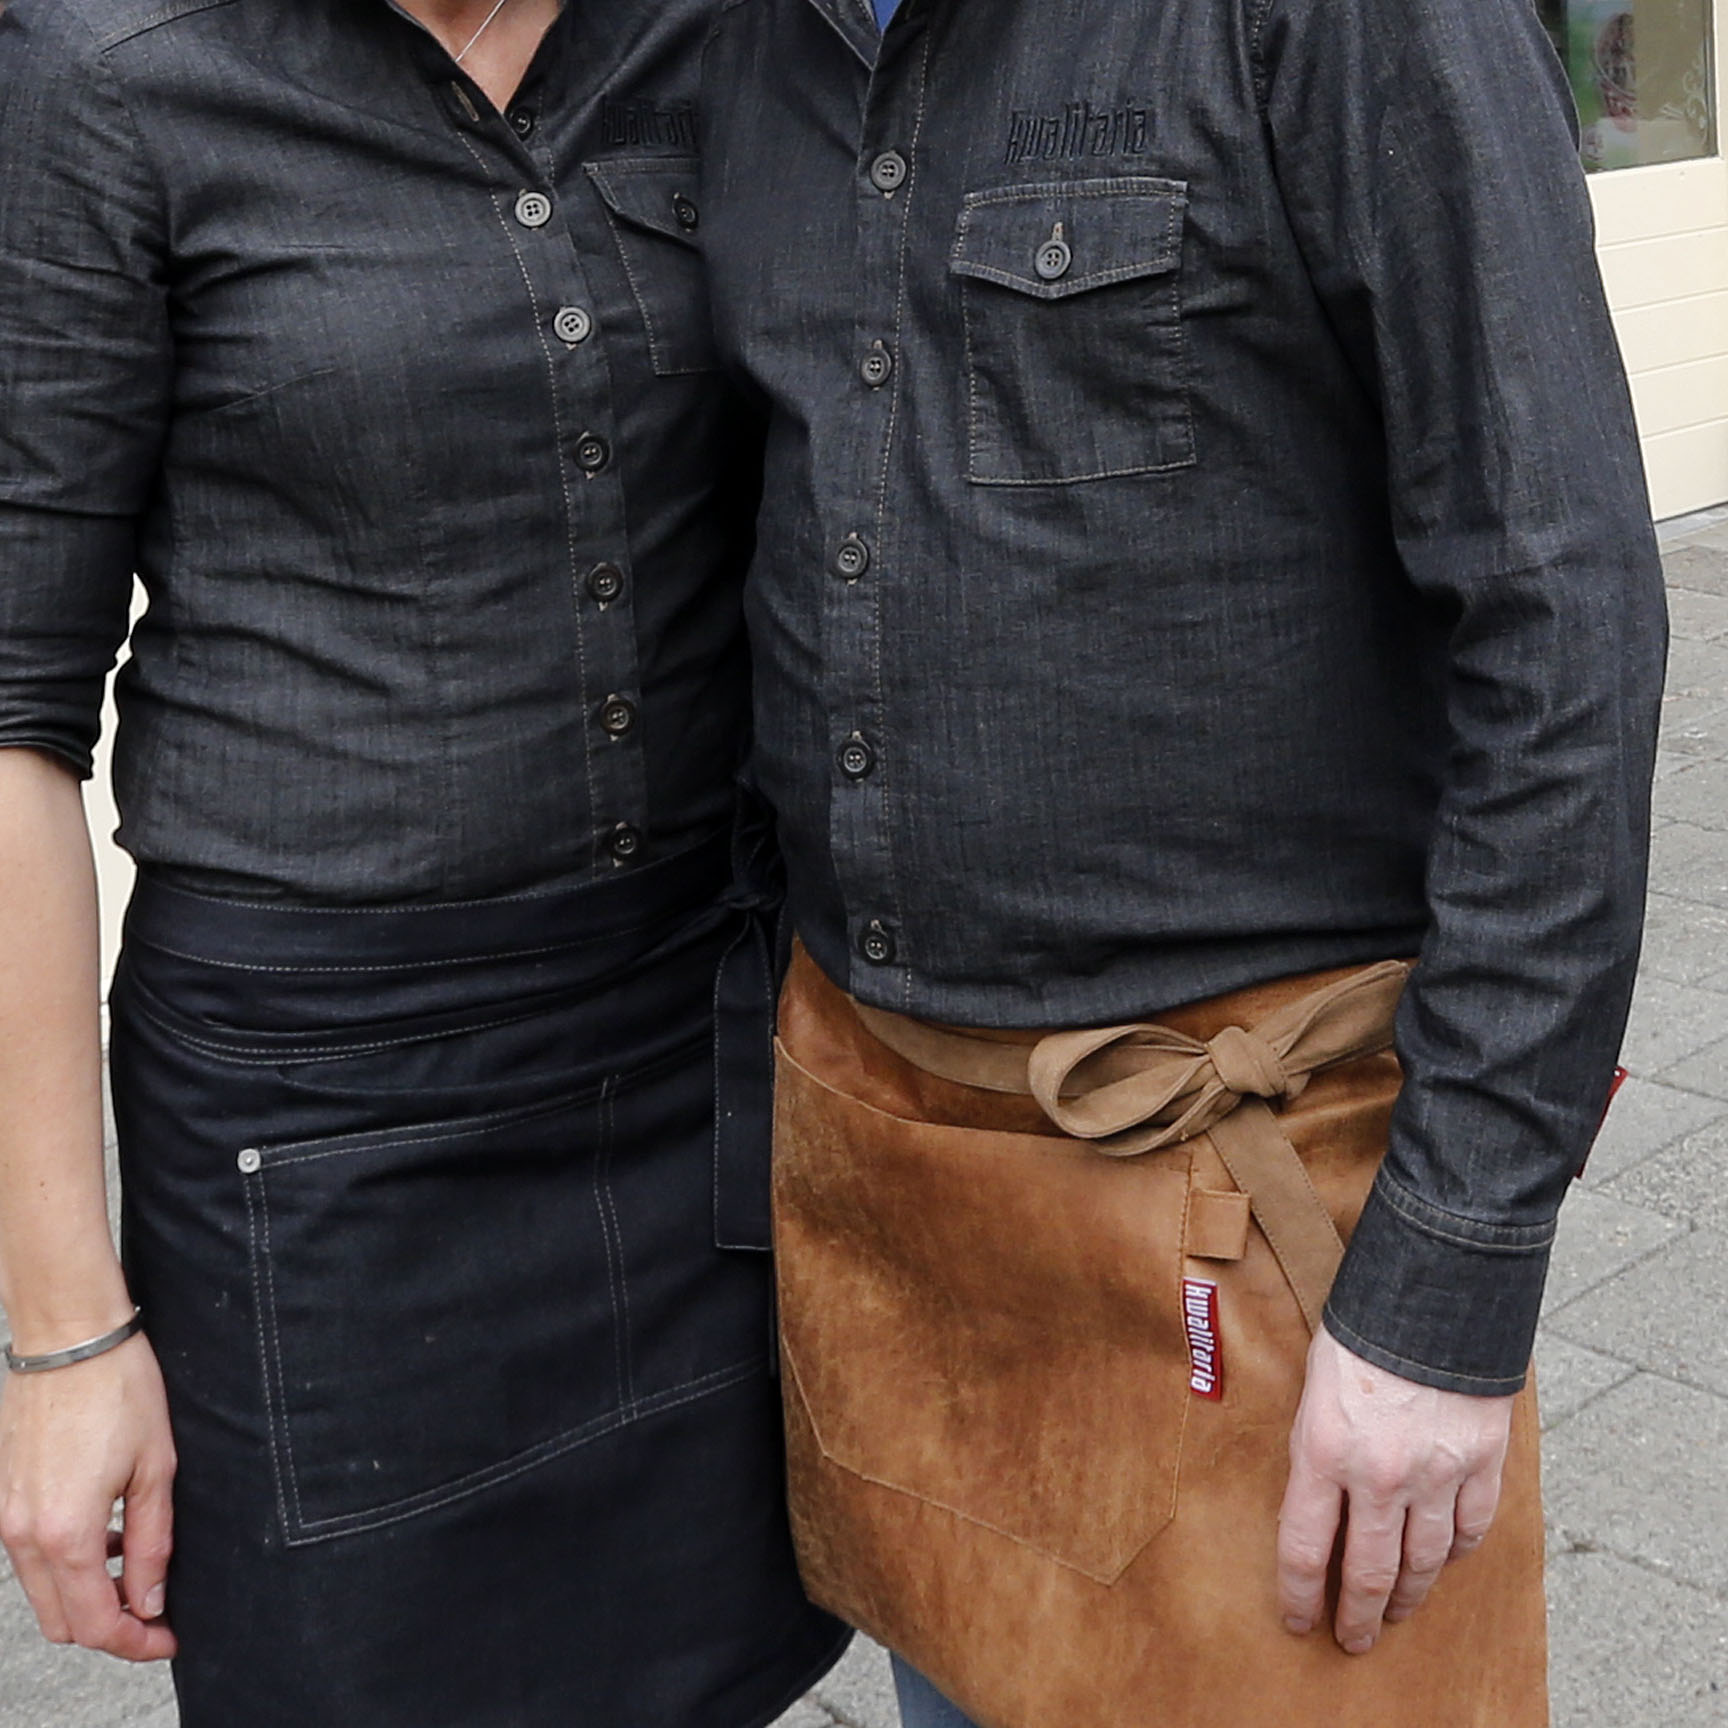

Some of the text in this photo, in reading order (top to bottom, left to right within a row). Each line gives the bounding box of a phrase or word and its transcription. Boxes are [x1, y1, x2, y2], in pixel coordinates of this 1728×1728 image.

[600, 94, 700, 146] kwalitari
[1004, 96, 1149, 165] kwalitaria
[1184, 1283, 1216, 1394] kwalitaria
